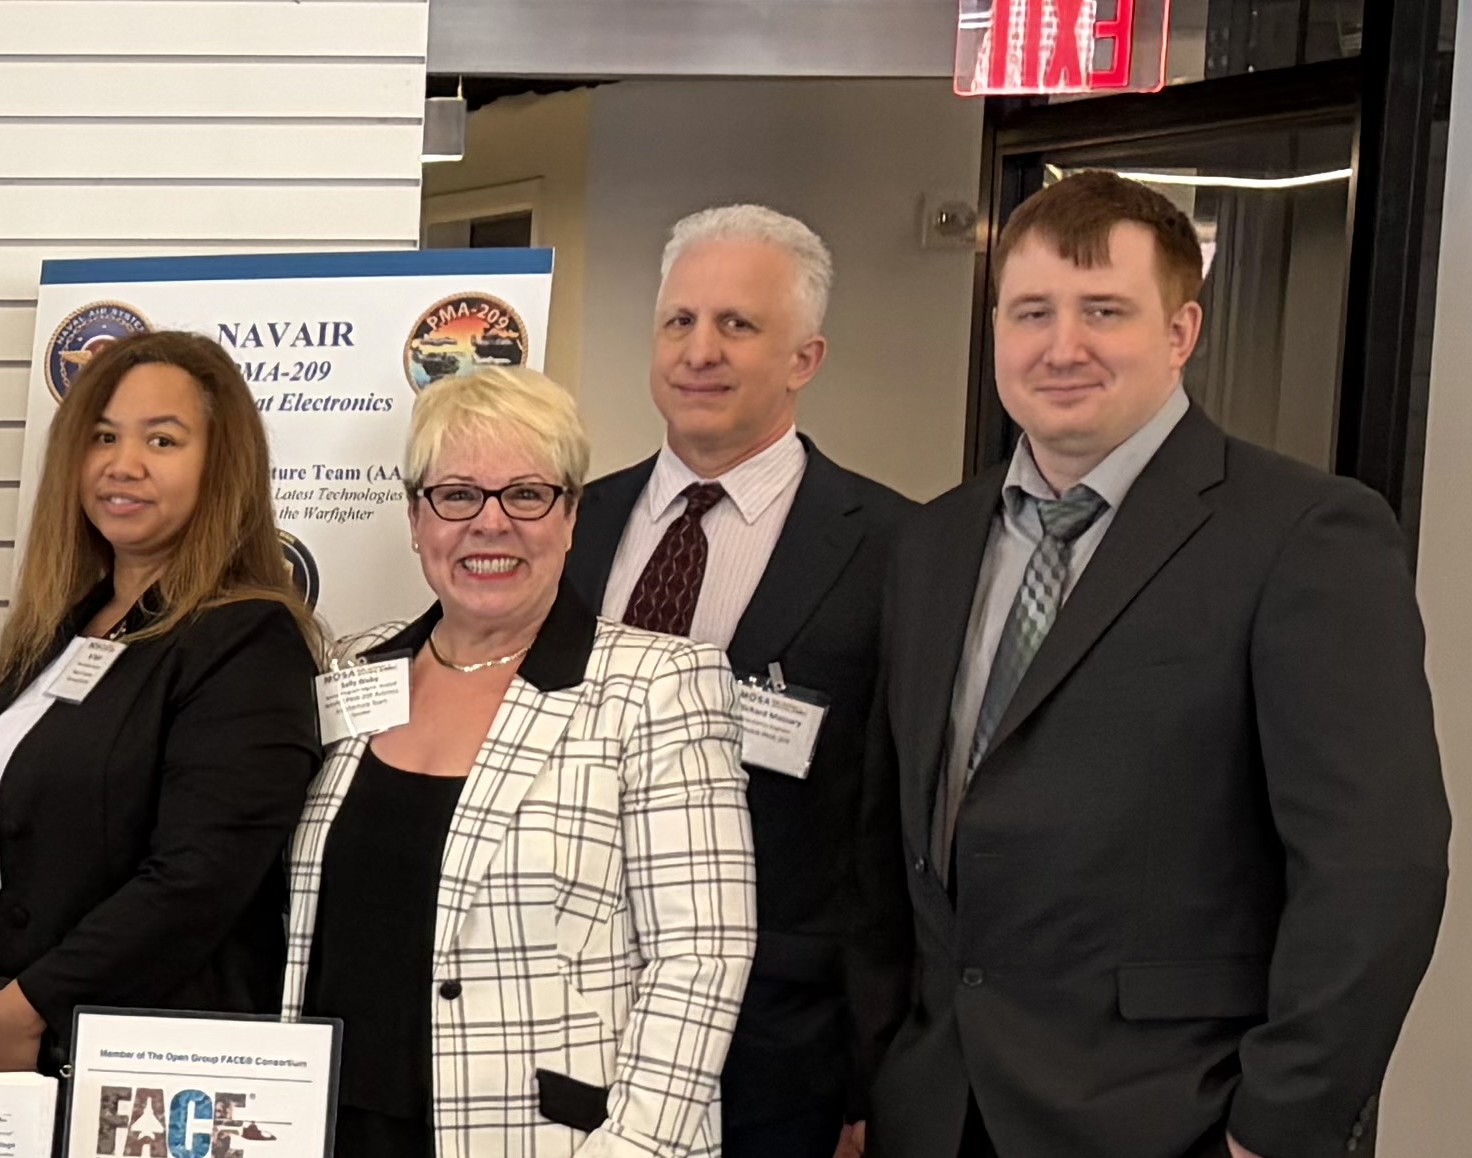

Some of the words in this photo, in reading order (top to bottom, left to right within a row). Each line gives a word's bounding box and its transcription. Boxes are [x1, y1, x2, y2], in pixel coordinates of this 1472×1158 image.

[426, 302, 509, 330] PMA-209
[217, 321, 355, 348] NAVAIR
[278, 393, 394, 412] Electronics
[312, 464, 361, 481] Team
[275, 487, 314, 501] Latest
[319, 487, 404, 505] Technologies
[279, 507, 300, 520] the
[304, 507, 375, 523] Warfighter
[100, 1048, 135, 1059] Member
[137, 1051, 146, 1060] of
[147, 1051, 164, 1060] The
[165, 1052, 189, 1063] Open
[191, 1053, 219, 1065] Group
[255, 1056, 308, 1068] Consortium
